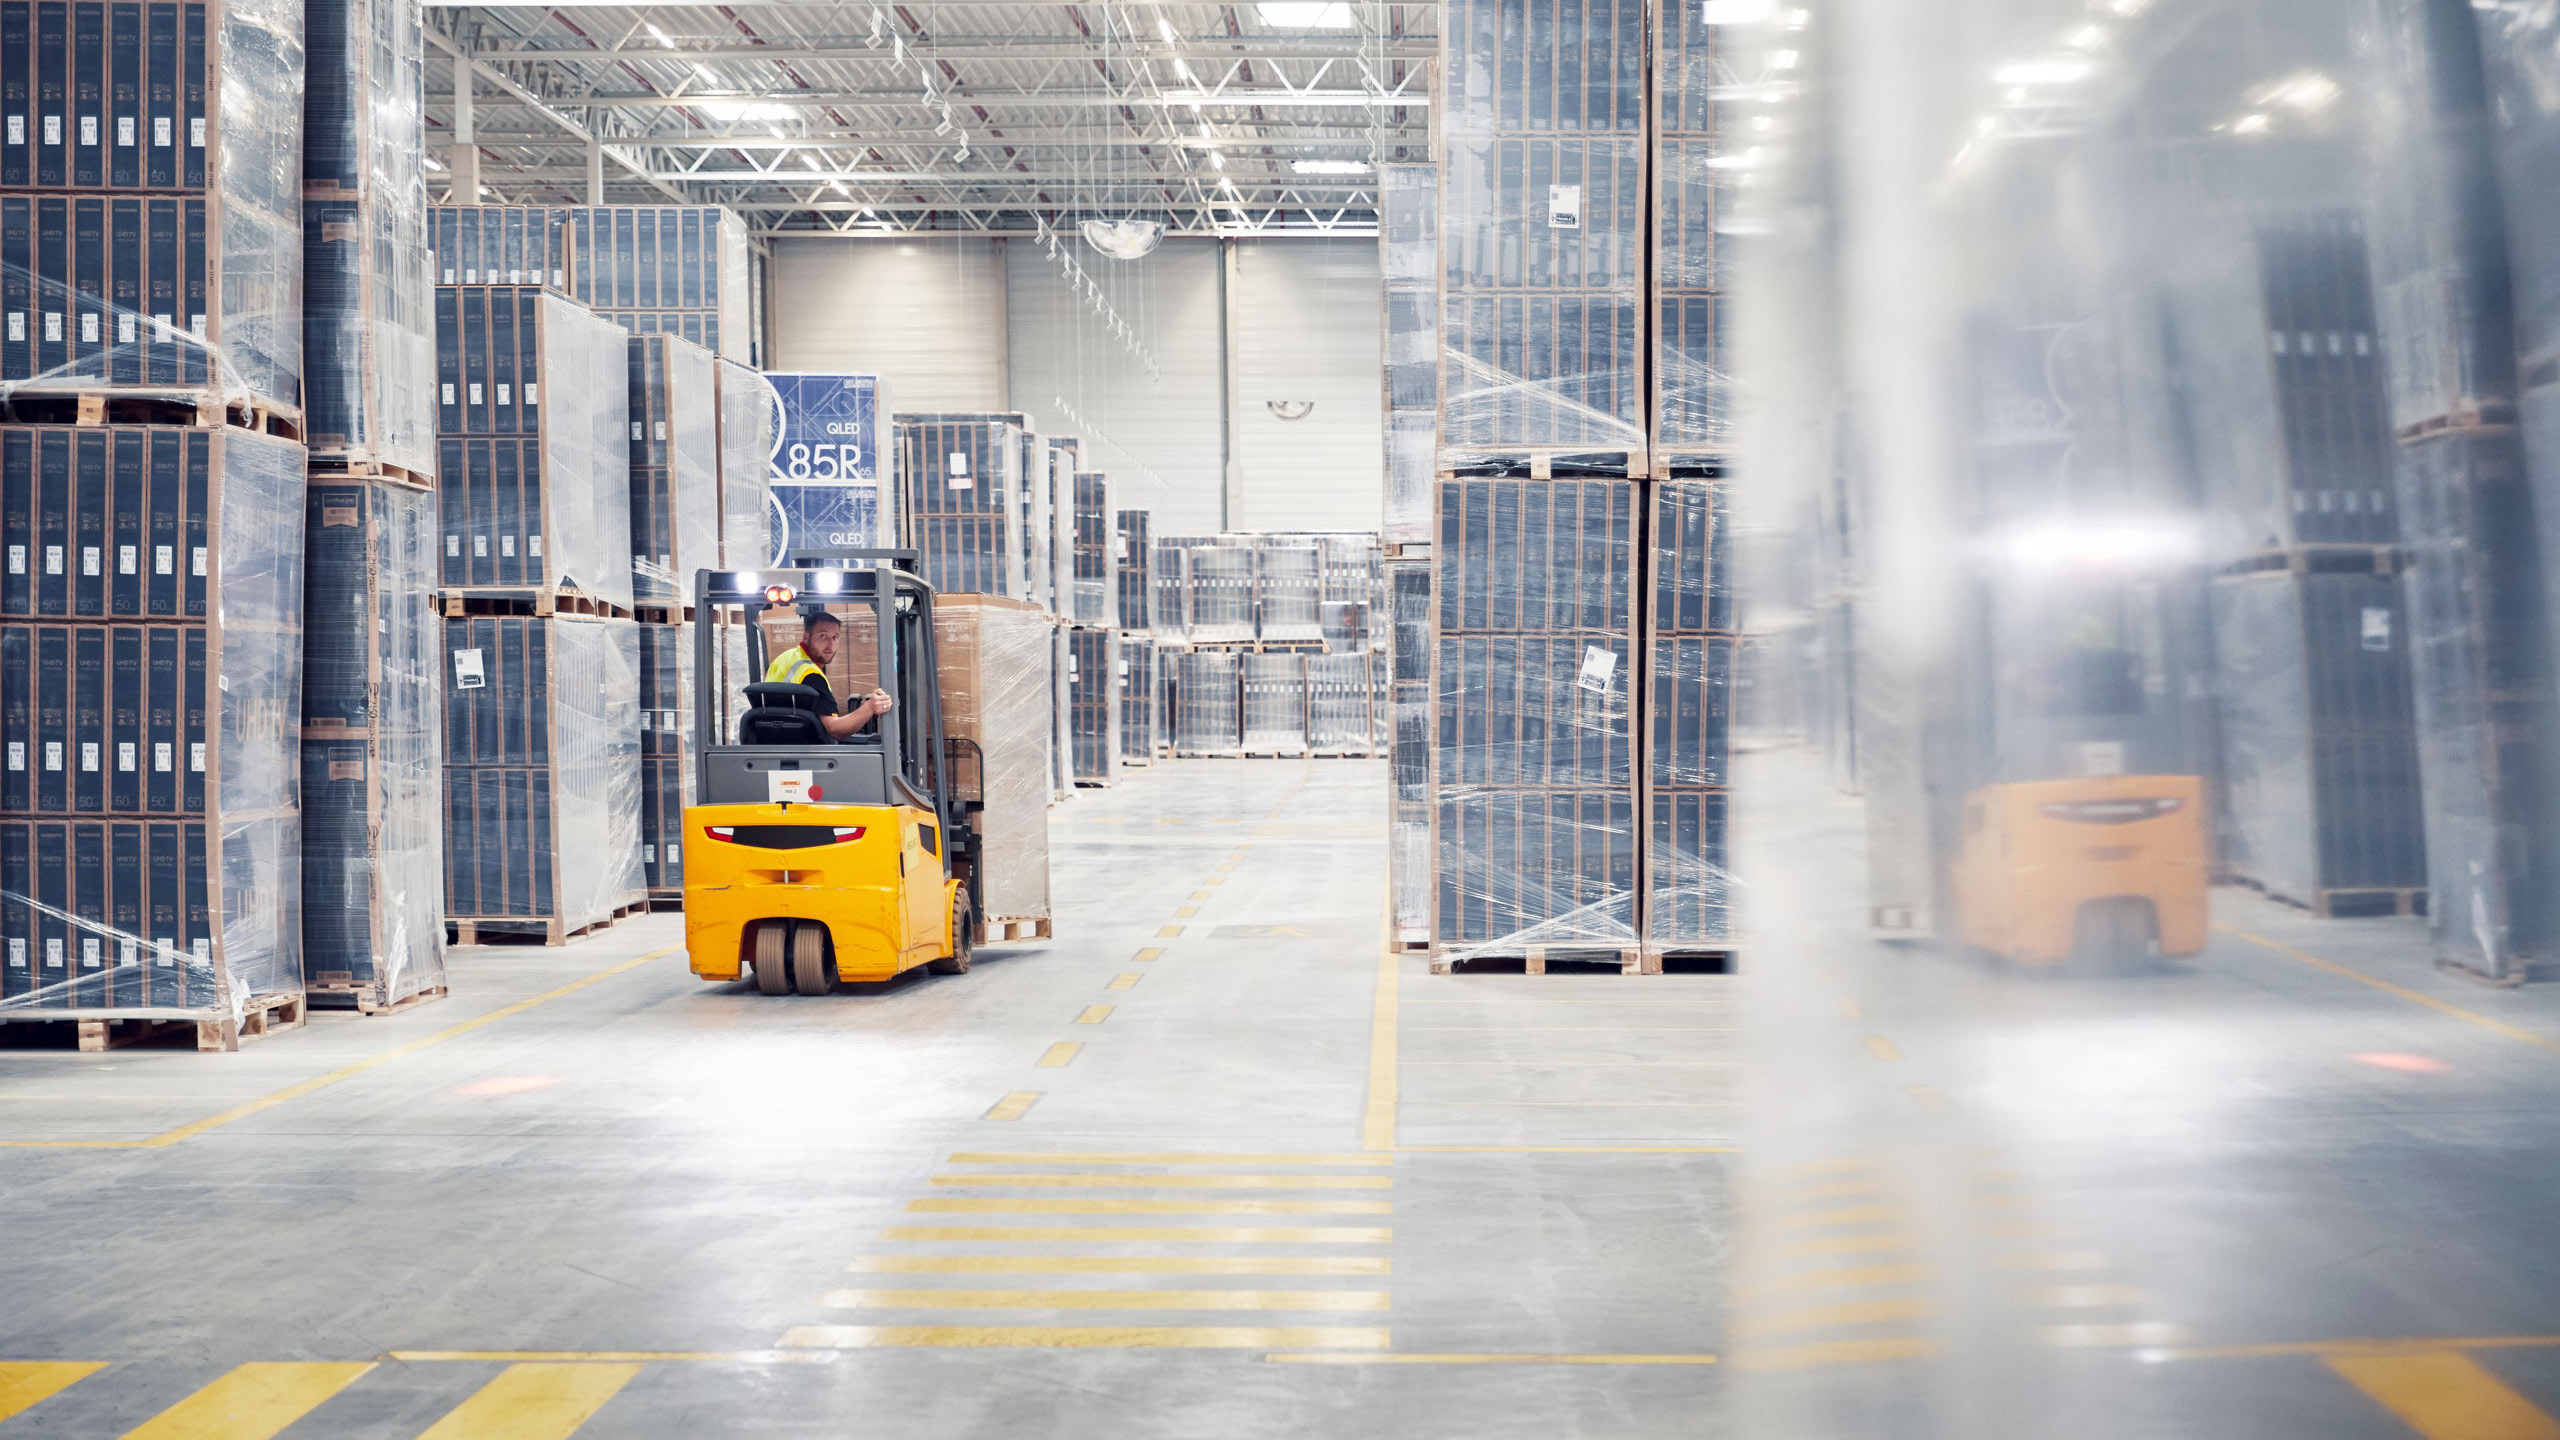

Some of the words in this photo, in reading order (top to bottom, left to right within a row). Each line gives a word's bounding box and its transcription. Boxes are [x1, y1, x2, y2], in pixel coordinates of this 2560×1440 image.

[827, 422, 860, 435] QLED
[788, 443, 863, 479] 85R
[860, 467, 872, 475] 65
[829, 533, 863, 545] QLED
